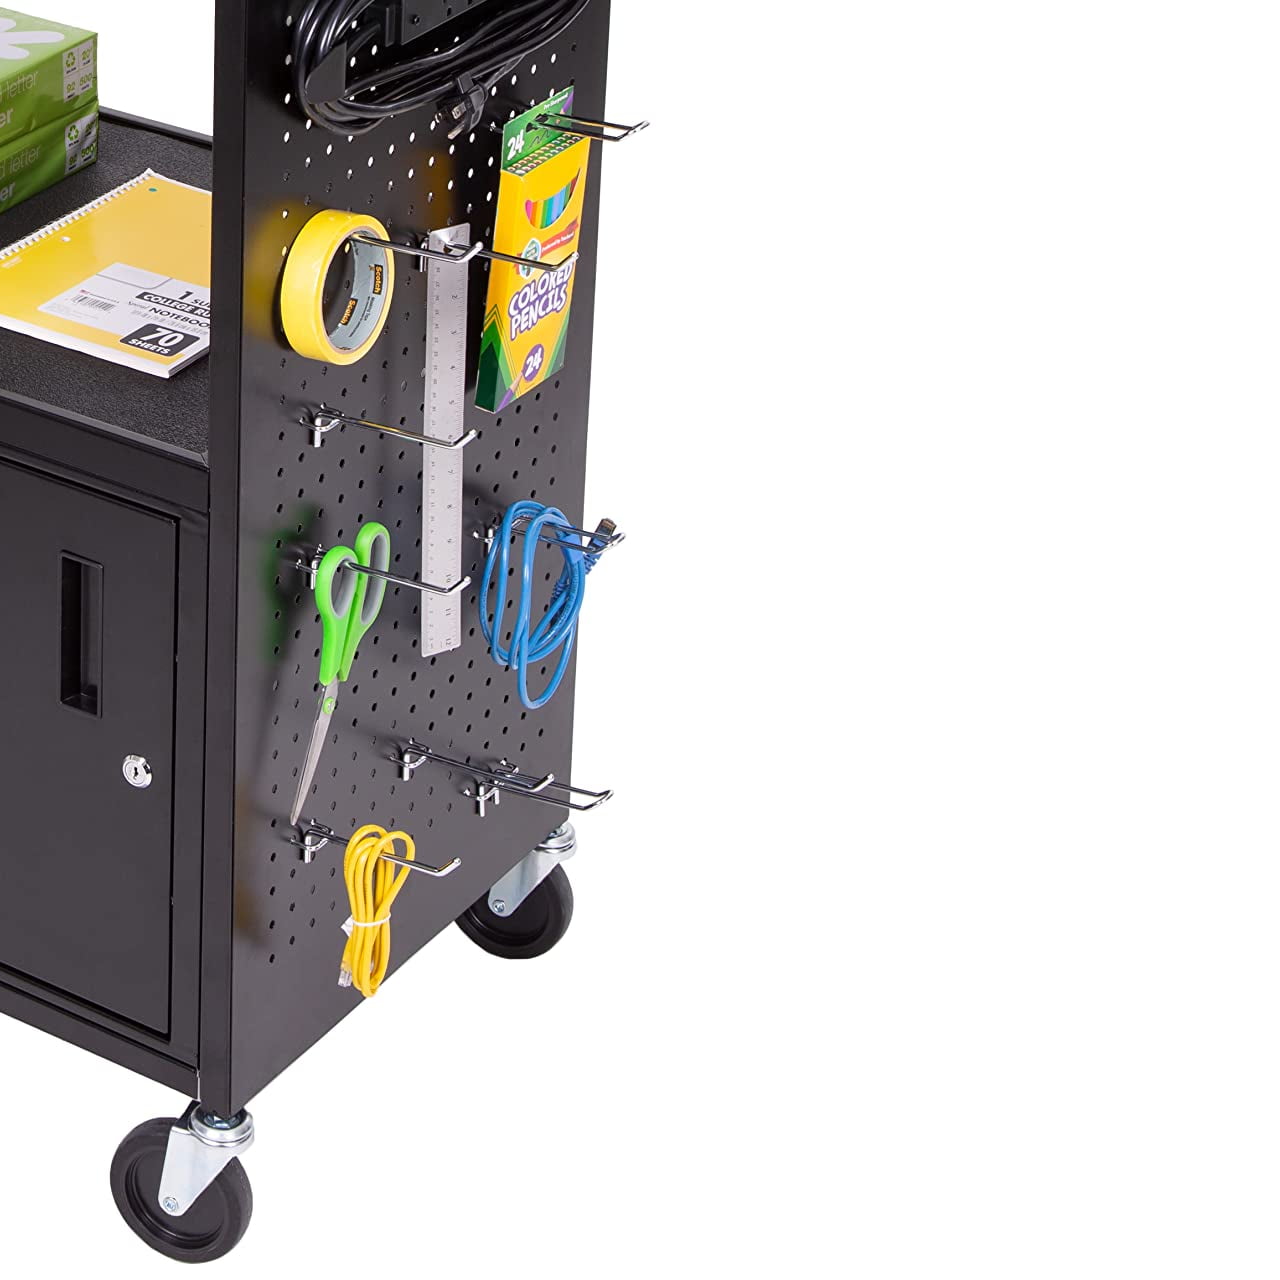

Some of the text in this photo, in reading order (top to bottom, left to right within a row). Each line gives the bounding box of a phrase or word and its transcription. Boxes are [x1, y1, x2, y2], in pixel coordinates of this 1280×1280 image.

[6, 71, 39, 103] letter
[507, 129, 525, 160] 24
[9, 145, 42, 175] letter
[373, 266, 382, 293] Scotch
[509, 261, 573, 317] COLORED
[144, 294, 195, 312] COLLEGE
[178, 291, 210, 308] 1 SU
[340, 299, 355, 325] Scotch
[511, 283, 567, 340] PENCILS
[149, 307, 210, 328] NOTEBOO
[128, 338, 171, 354] SHEETS
[140, 327, 184, 347] 70
[524, 347, 542, 378] 24
